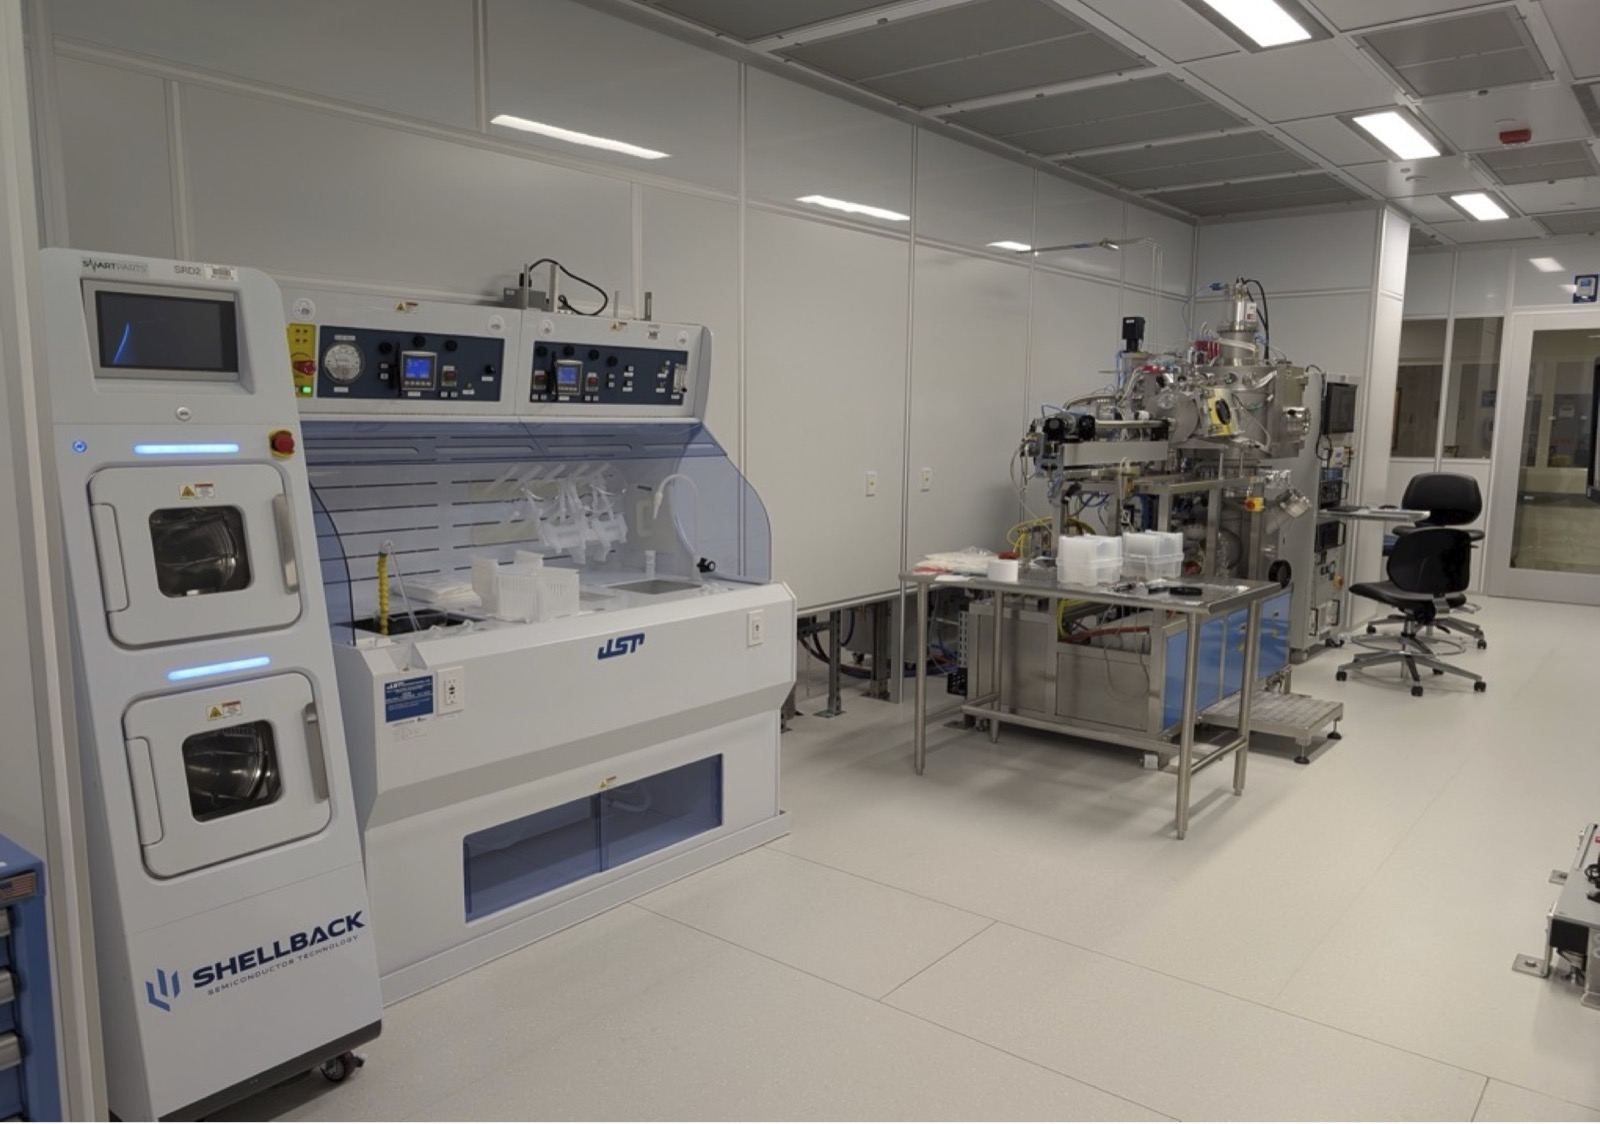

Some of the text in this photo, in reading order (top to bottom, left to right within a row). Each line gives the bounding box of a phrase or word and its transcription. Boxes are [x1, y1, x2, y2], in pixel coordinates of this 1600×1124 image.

[597, 633, 645, 660] JST
[192, 910, 365, 989] SHELLBACK
[207, 934, 359, 996] SEMICONDUCTOR TECHNOLOGY
